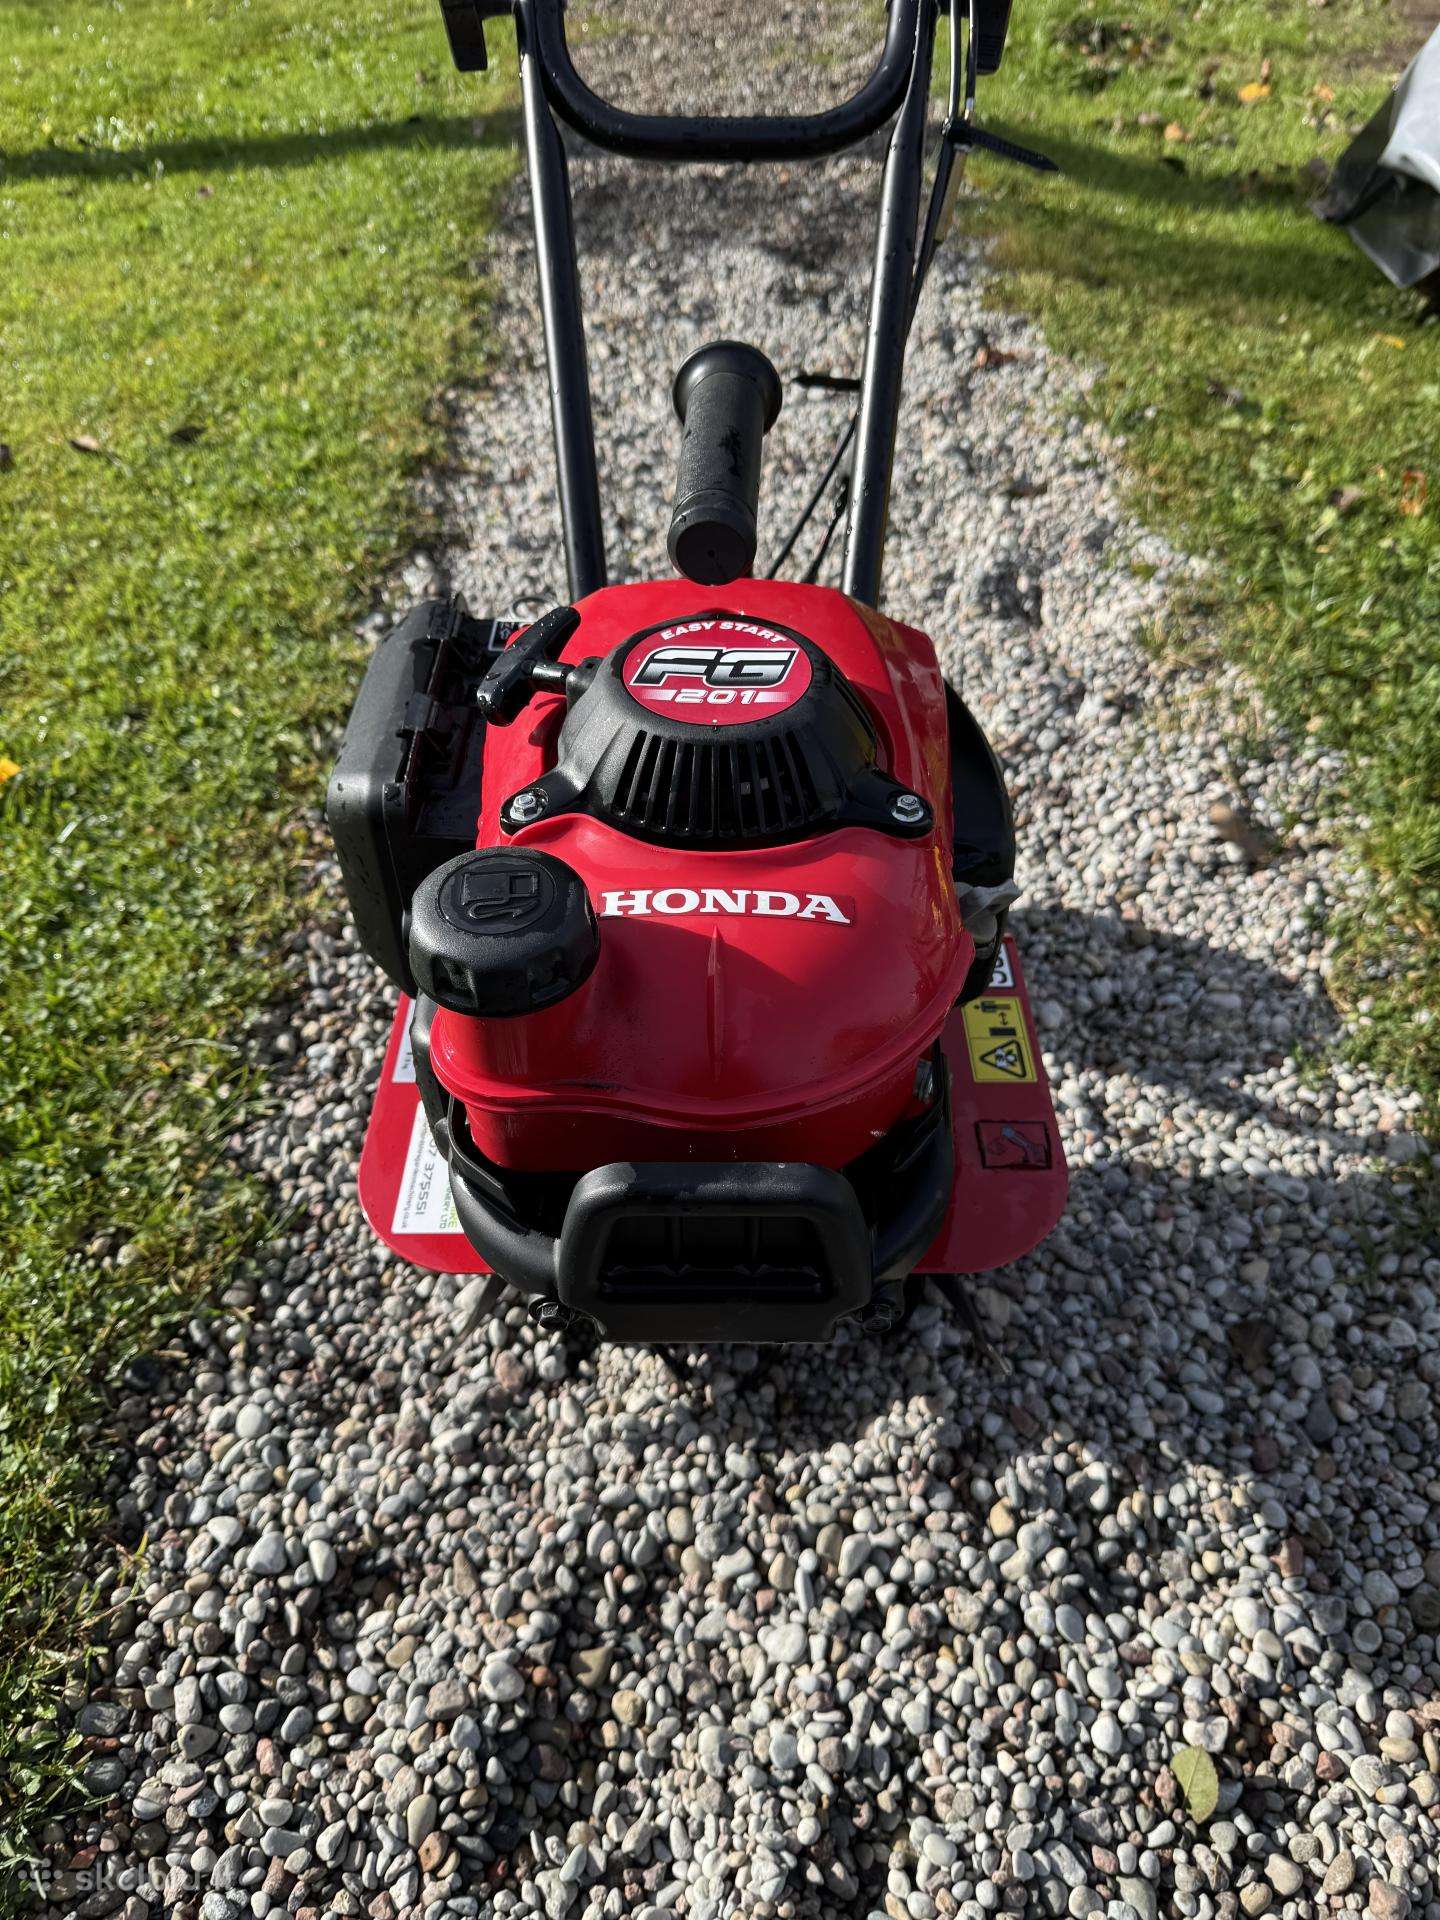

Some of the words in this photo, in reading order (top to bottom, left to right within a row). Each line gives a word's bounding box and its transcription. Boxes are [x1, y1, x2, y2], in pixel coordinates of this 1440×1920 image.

[661, 621, 716, 641] EASY
[719, 621, 788, 644] START
[629, 645, 800, 689] FG
[674, 688, 757, 705] 201
[601, 888, 851, 924] HONDA
